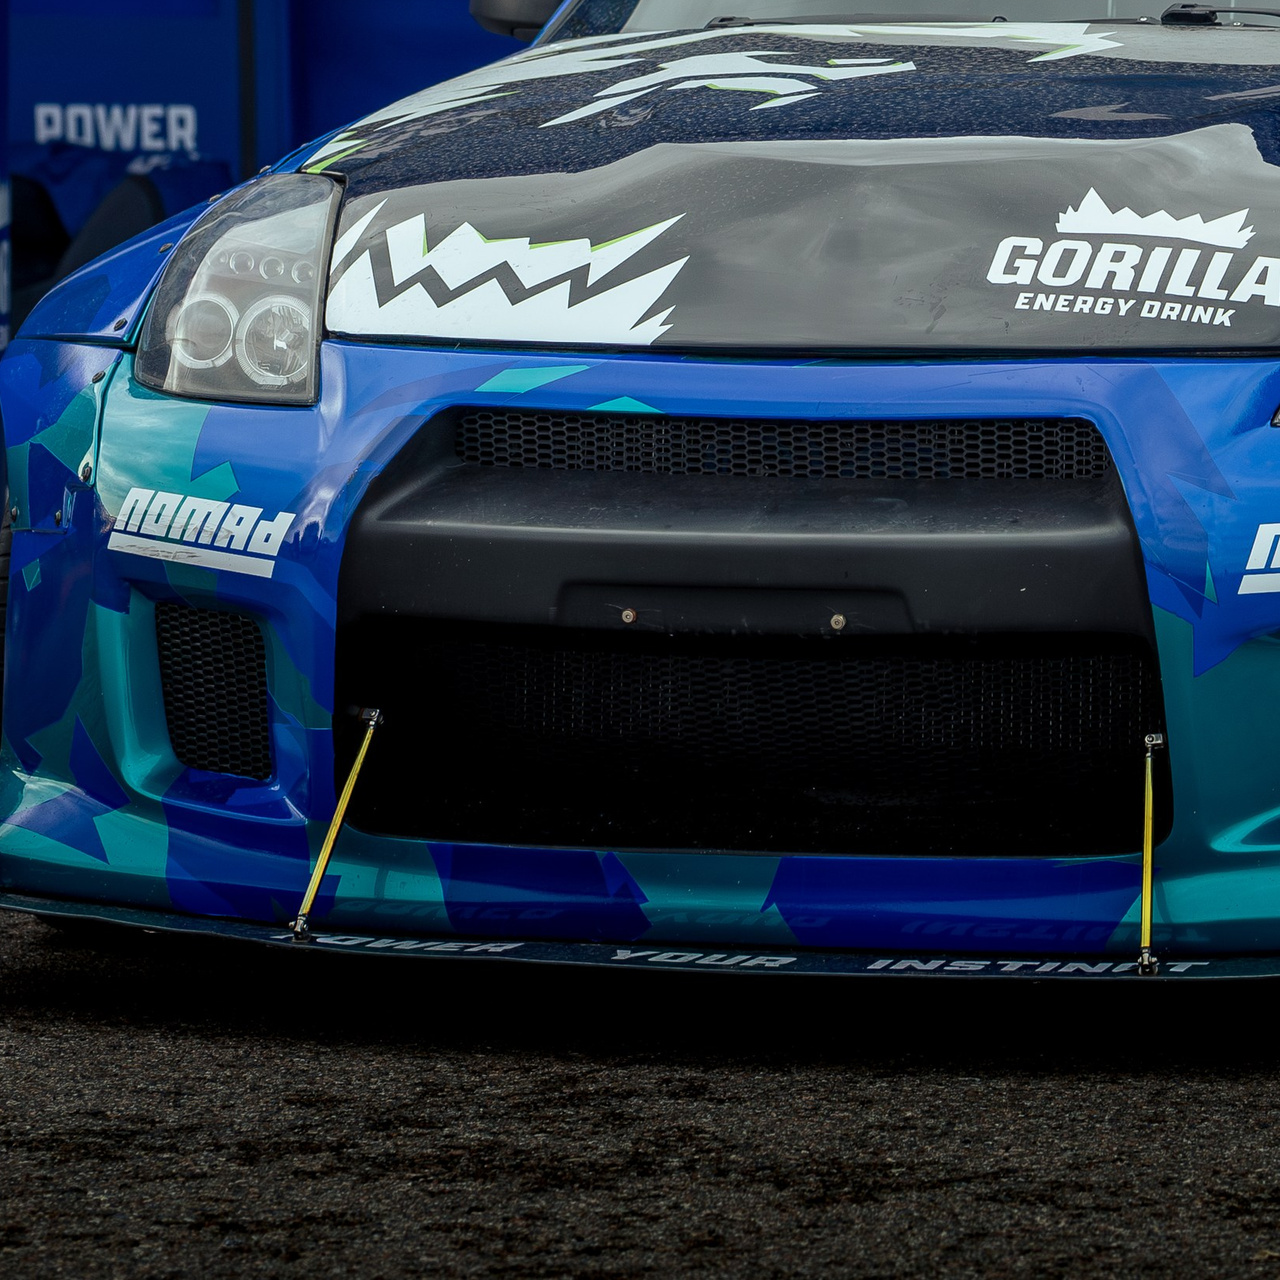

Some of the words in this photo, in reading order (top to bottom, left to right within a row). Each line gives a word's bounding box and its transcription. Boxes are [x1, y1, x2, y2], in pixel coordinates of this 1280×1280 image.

[34, 103, 198, 152] POWER
[1014, 292, 1136, 317] ENERGY
[1140, 300, 1235, 327] DRINK
[611, 949, 797, 967] YOUR
